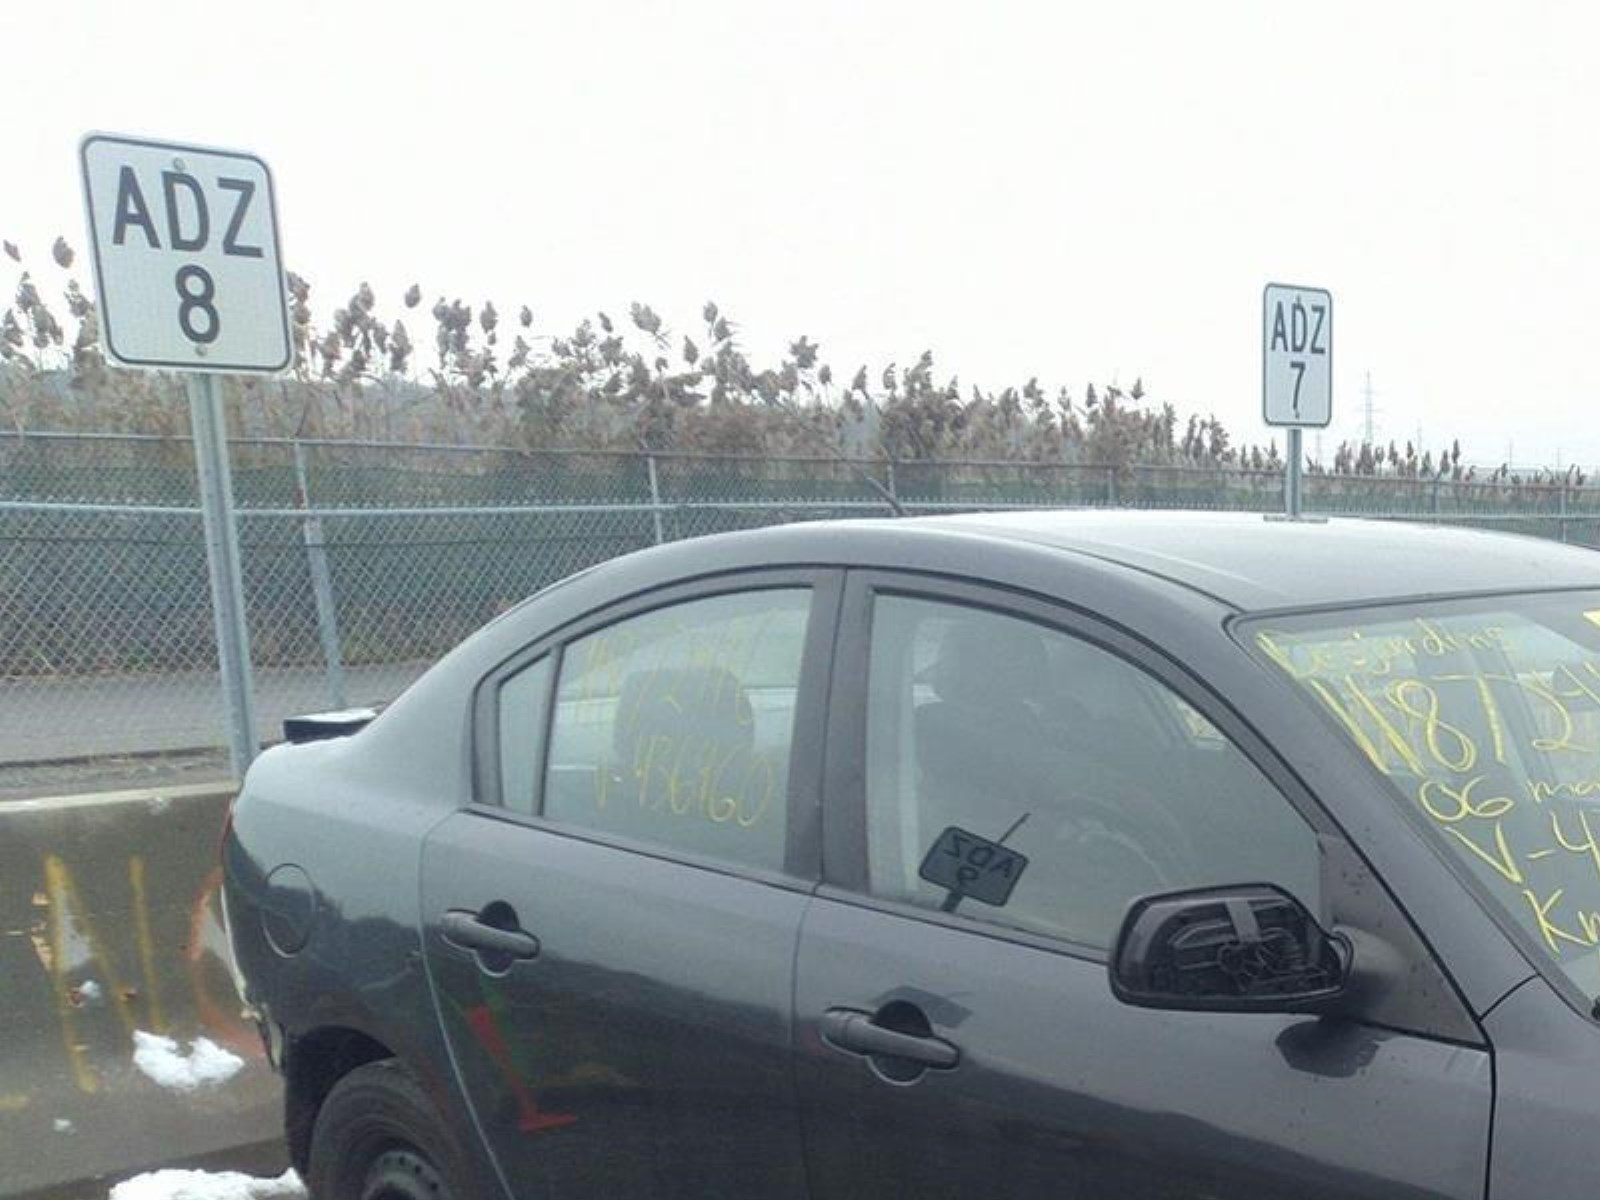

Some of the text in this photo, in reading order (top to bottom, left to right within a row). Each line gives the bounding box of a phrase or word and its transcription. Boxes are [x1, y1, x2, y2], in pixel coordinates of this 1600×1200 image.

[112, 165, 264, 258] ADZ
[175, 264, 220, 344] 8
[1271, 301, 1326, 354] ADZ
[1290, 361, 1306, 410] 7
[1418, 775, 1516, 824] 06
